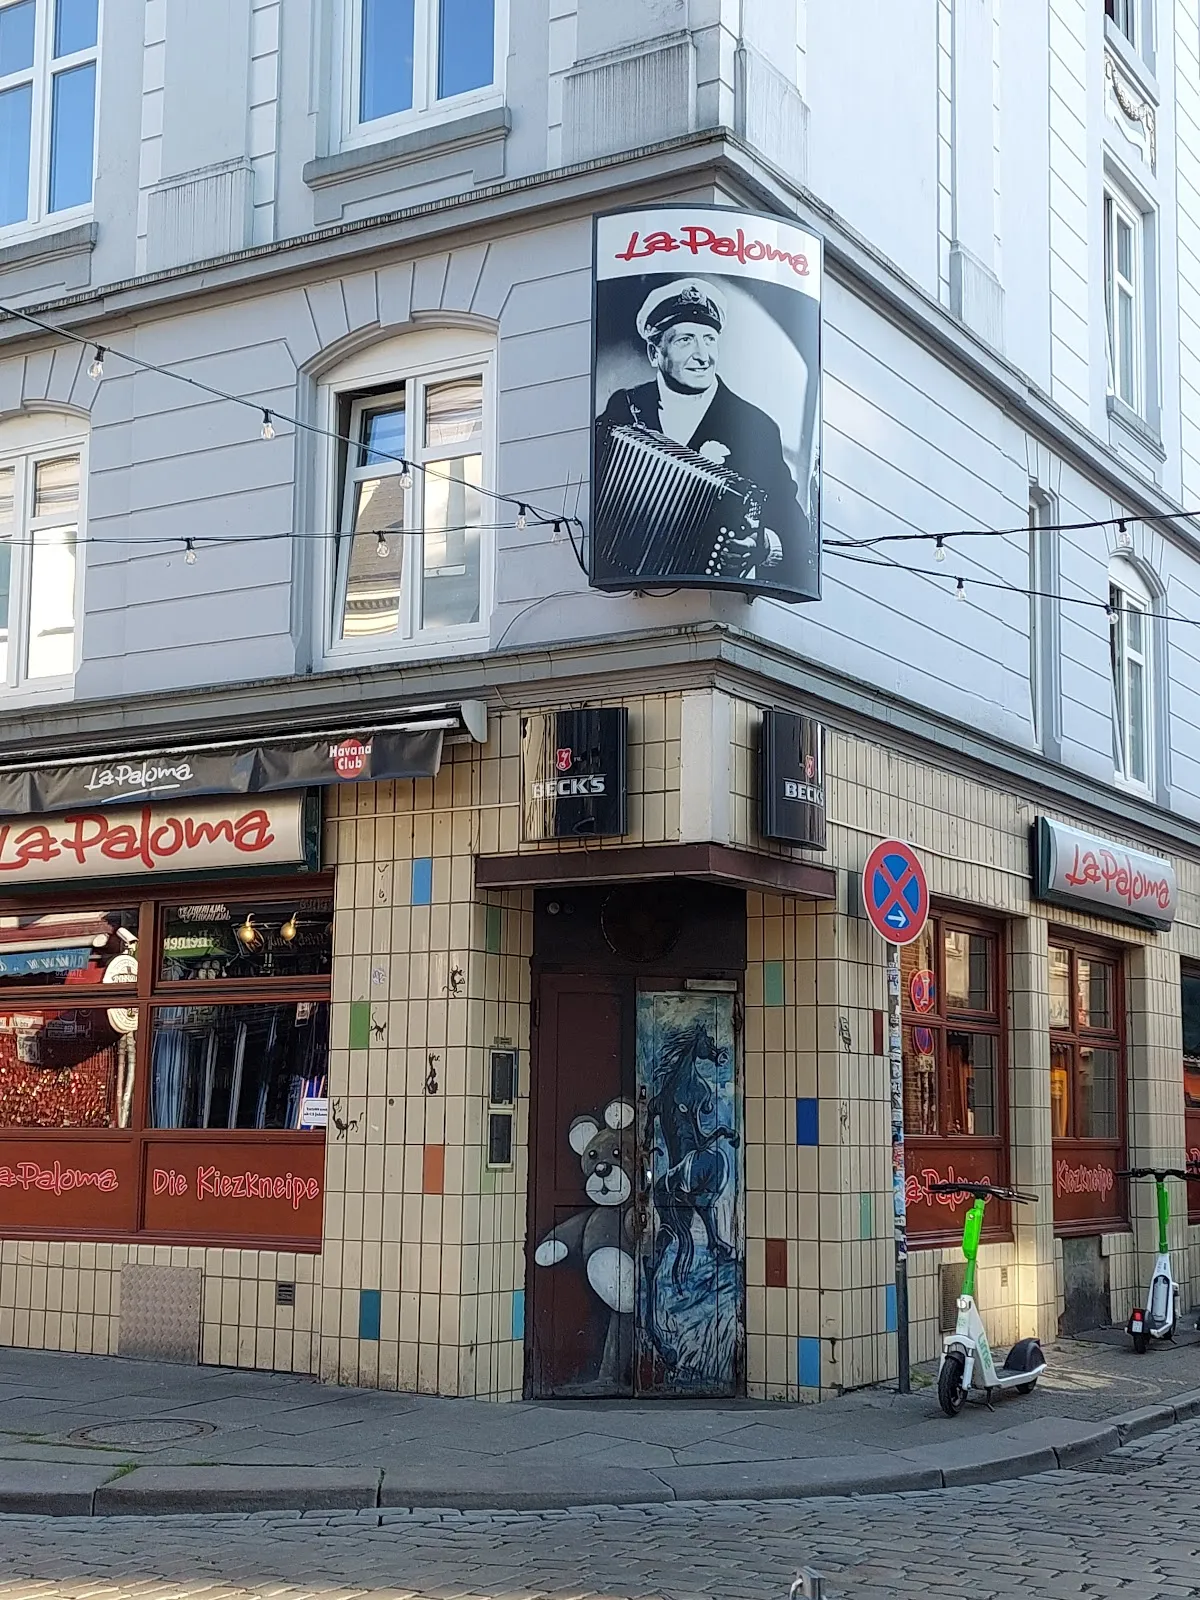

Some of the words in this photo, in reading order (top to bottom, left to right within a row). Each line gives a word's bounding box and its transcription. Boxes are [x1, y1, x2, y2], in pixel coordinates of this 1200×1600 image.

[615, 231, 681, 261] La
[679, 226, 811, 276] Paloma
[329, 744, 372, 758] Havana
[337, 756, 363, 770] Club
[114, 761, 194, 787] Paloma
[531, 774, 606, 799] BECK'S
[60, 805, 275, 869] Paloma
[1098, 848, 1170, 909] Paloma
[0, 1165, 17, 1188] a
[16, 1160, 119, 1196] Paloma
[152, 1166, 189, 1196] Die
[196, 1165, 320, 1211] Kiezkneipe
[905, 1175, 924, 1207] a
